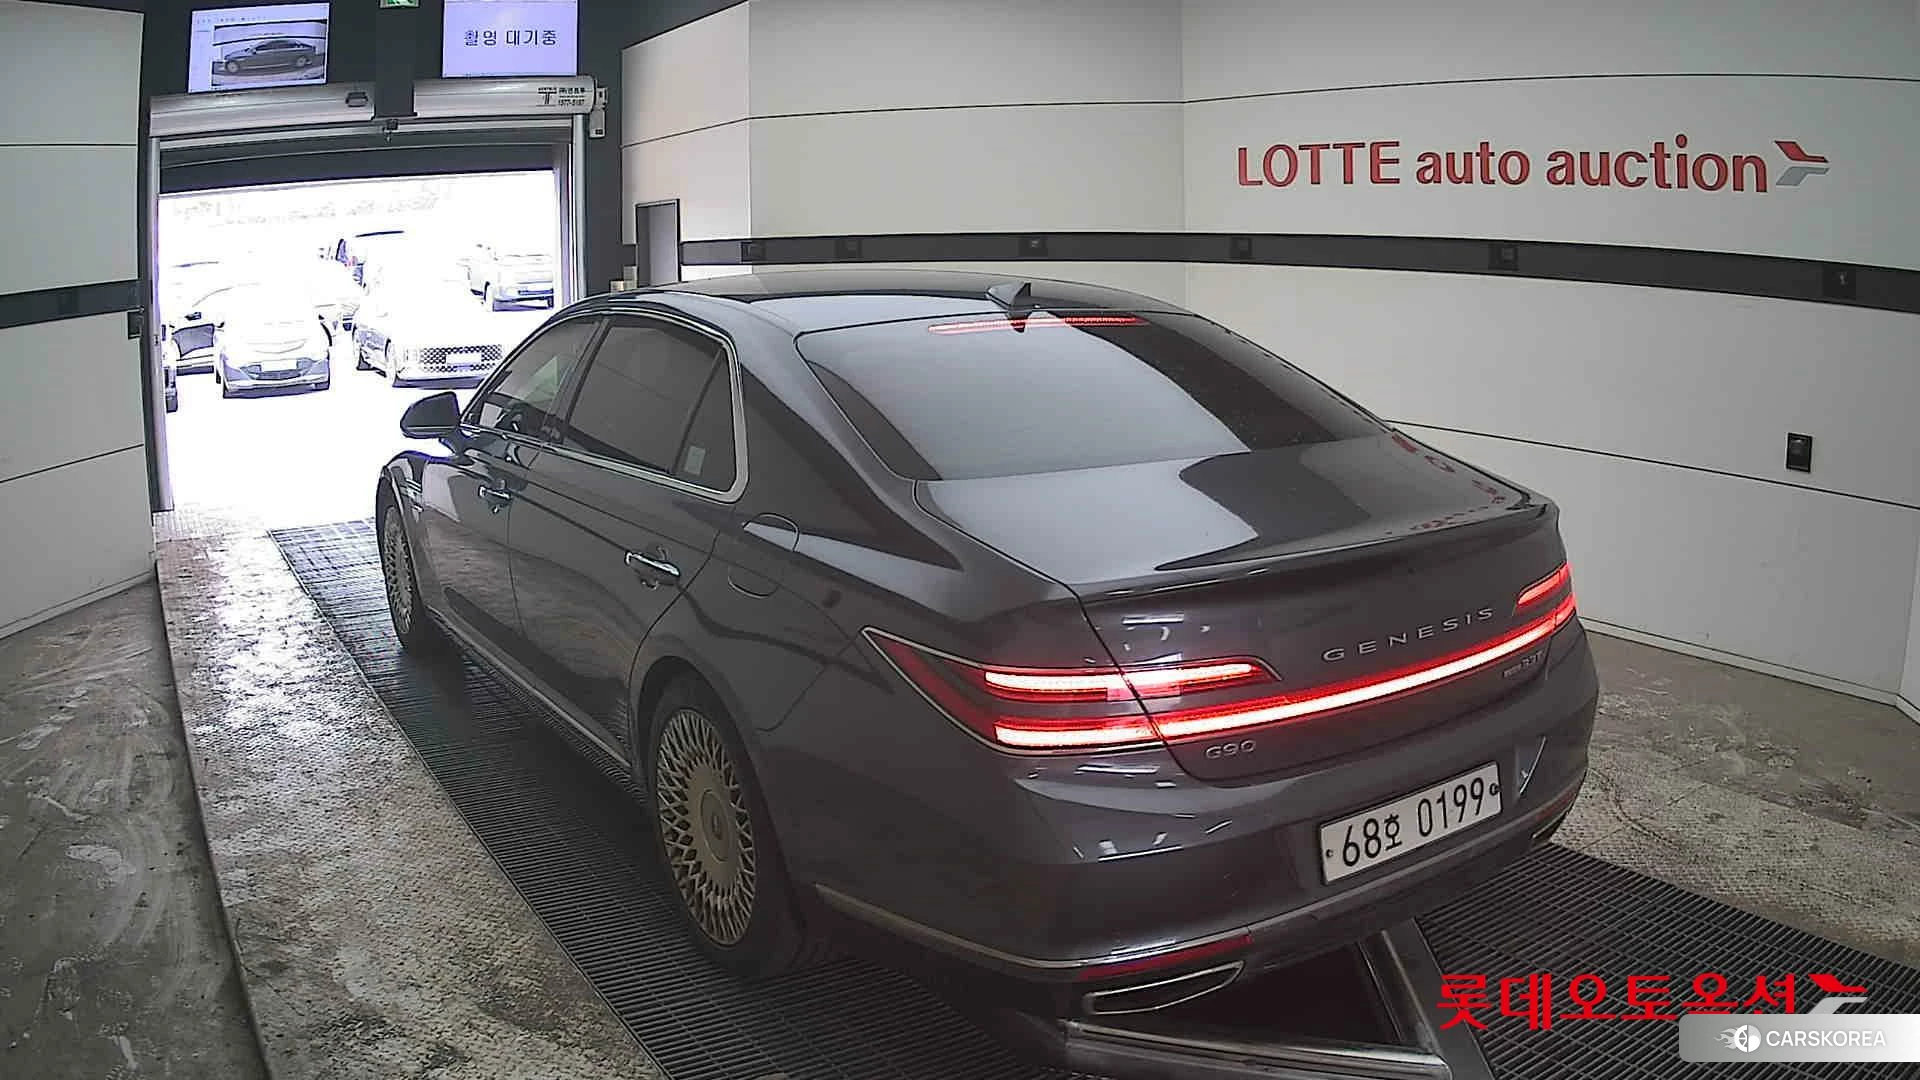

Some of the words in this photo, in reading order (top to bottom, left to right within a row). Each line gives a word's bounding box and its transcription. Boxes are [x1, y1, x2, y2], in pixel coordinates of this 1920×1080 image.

[506, 30, 557, 46] 대기중
[1238, 141, 1400, 187] LOTTE
[1415, 141, 1530, 185] auto
[1546, 134, 1768, 193] auction
[1322, 607, 1493, 662] GENESIS
[1206, 740, 1256, 760] G90
[1342, 813, 1403, 867] 68호
[1417, 777, 1485, 837] 0199
